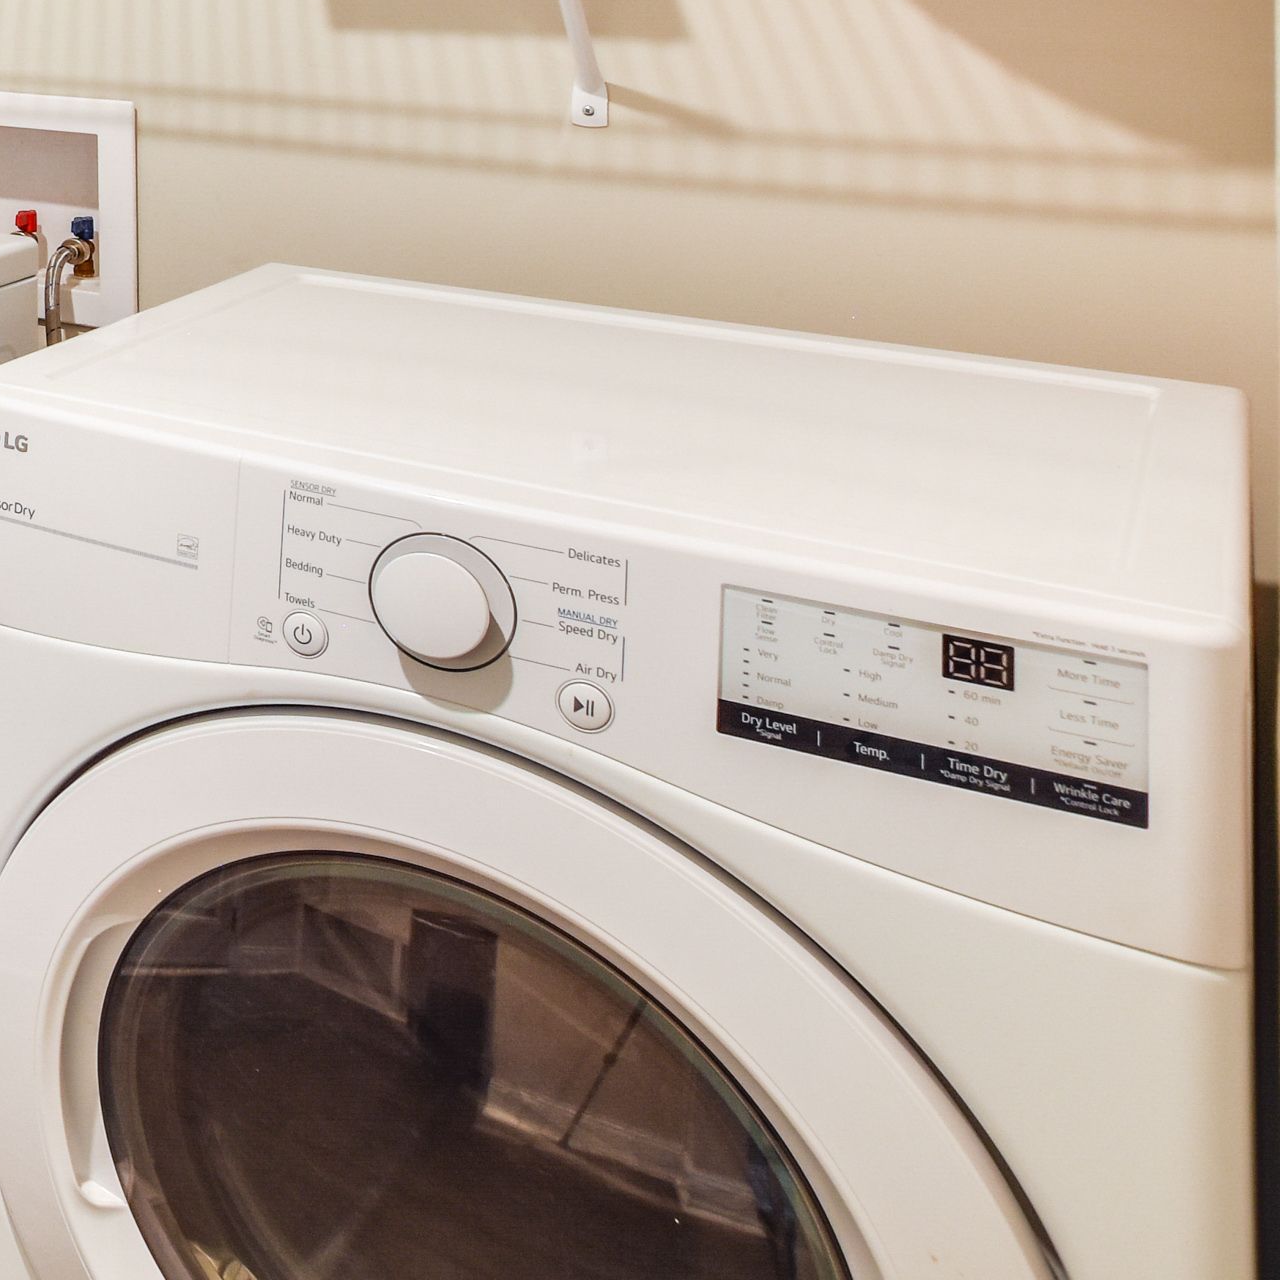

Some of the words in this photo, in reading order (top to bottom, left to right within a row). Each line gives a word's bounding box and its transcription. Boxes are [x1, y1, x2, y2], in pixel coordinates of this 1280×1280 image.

[3, 431, 29, 453] LG
[290, 479, 319, 493] SENSOR
[321, 485, 336, 496] DRY
[289, 490, 324, 506] Normal
[287, 524, 316, 541] Heavy
[318, 531, 342, 547] Duty
[568, 548, 621, 568] Delicates
[285, 558, 323, 578] Bedding
[284, 592, 315, 609] Towels
[552, 582, 584, 599] Perm.
[588, 589, 620, 605] Press
[558, 607, 595, 623] MANUAL
[599, 616, 618, 628] DRY
[821, 615, 836, 626] Dry
[558, 621, 593, 638] Speed
[597, 629, 618, 645] Dry
[757, 648, 779, 661] Very
[872, 648, 896, 661] Damp
[898, 653, 914, 663] Dry
[575, 663, 592, 675] Air
[596, 667, 617, 683] Dry
[756, 672, 792, 687] Normal
[858, 669, 882, 682] High
[1057, 669, 1088, 684] More
[1091, 674, 1121, 690] Time
[756, 696, 784, 710] Damp
[858, 693, 898, 709] Medium
[963, 690, 978, 701] 60
[981, 694, 1001, 706] min
[741, 712, 762, 728] Dry
[766, 717, 797, 735] Level
[858, 718, 878, 730] Low
[964, 716, 979, 726] 40
[1060, 710, 1087, 723] Less
[1090, 716, 1120, 731] Time
[853, 741, 890, 761] Temp.
[964, 740, 979, 752] 20
[1051, 745, 1091, 764] Energy
[1095, 755, 1129, 770] Saver
[947, 757, 980, 775] Time
[983, 765, 1008, 782] Dry
[969, 774, 984, 787] Dry
[1053, 781, 1099, 802] Wrinkle
[1102, 793, 1132, 809] Care
[1099, 803, 1120, 817] Lock
